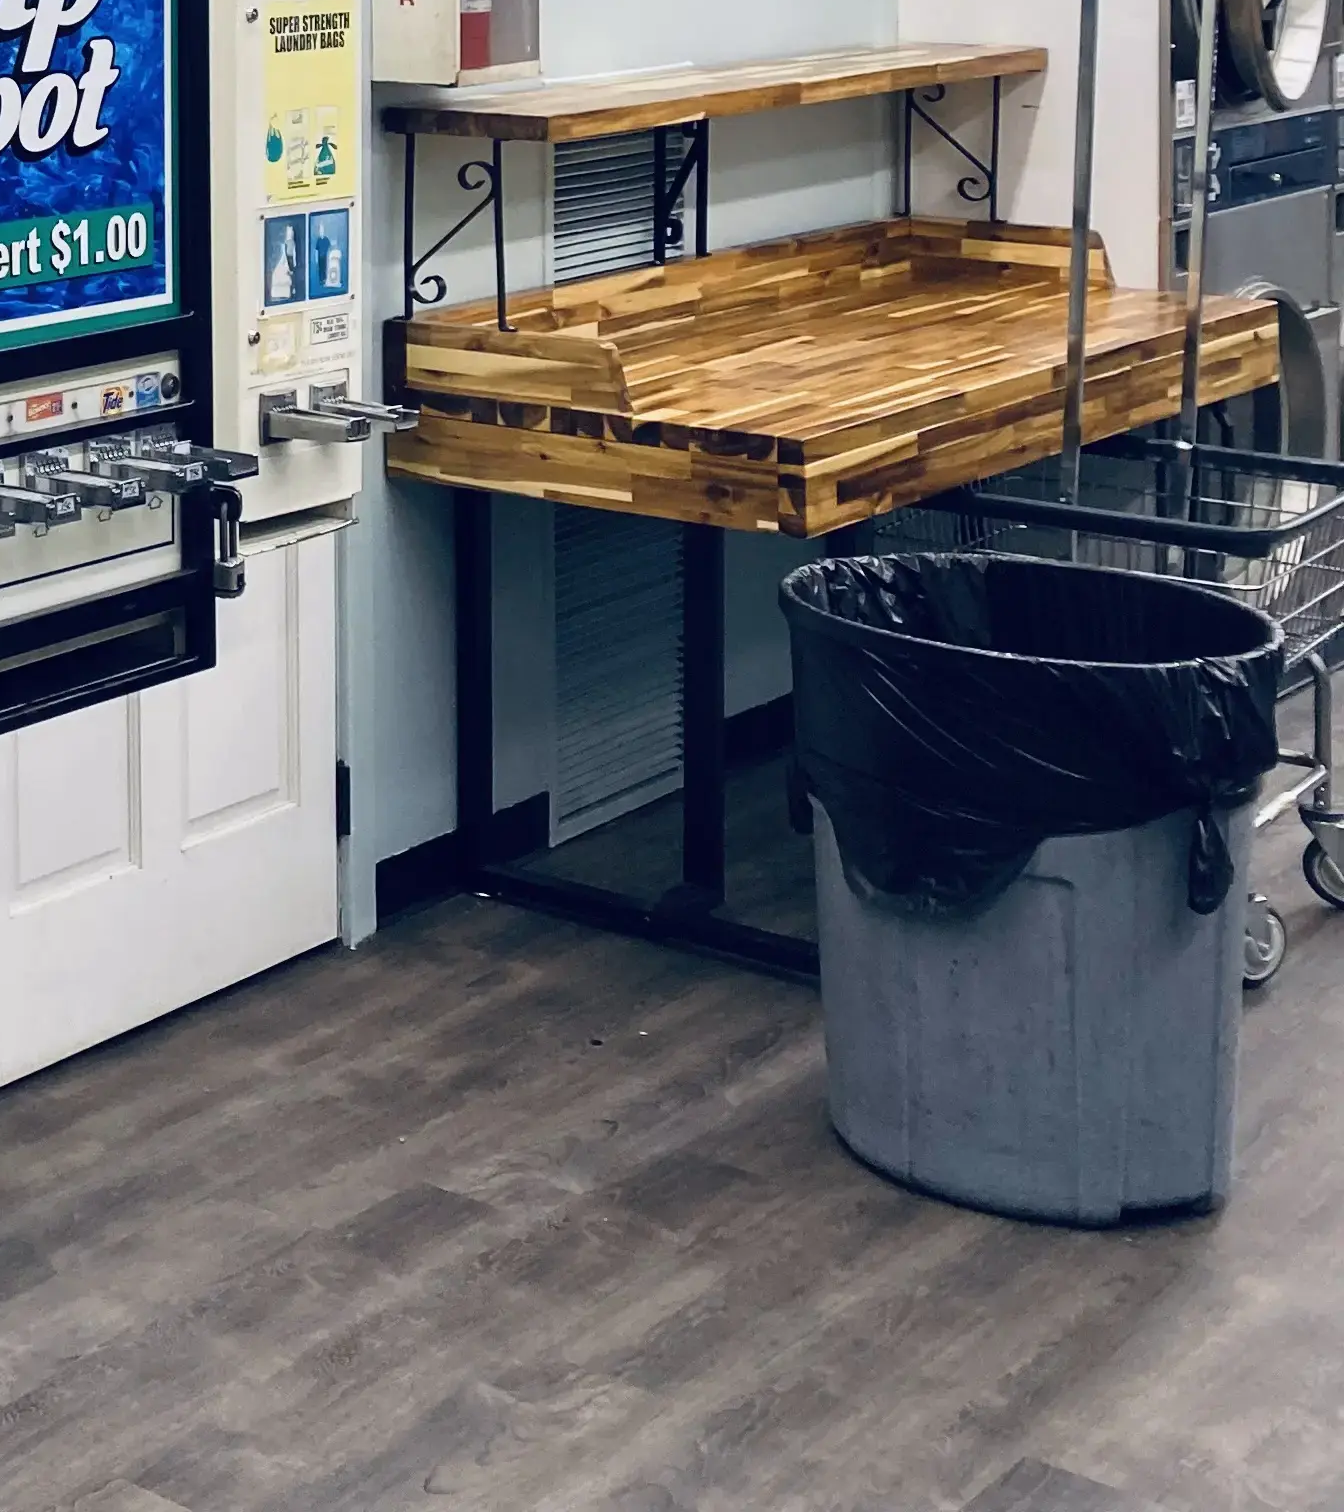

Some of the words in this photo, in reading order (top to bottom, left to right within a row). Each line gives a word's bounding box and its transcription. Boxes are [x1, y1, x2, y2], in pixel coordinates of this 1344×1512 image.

[269, 16, 300, 35] SUPER
[302, 11, 350, 32] STRENGTH
[275, 33, 318, 54] LAUNDRY
[320, 30, 345, 49] BAGS
[51, 211, 148, 278] $1.00
[103, 392, 123, 413] Tide
